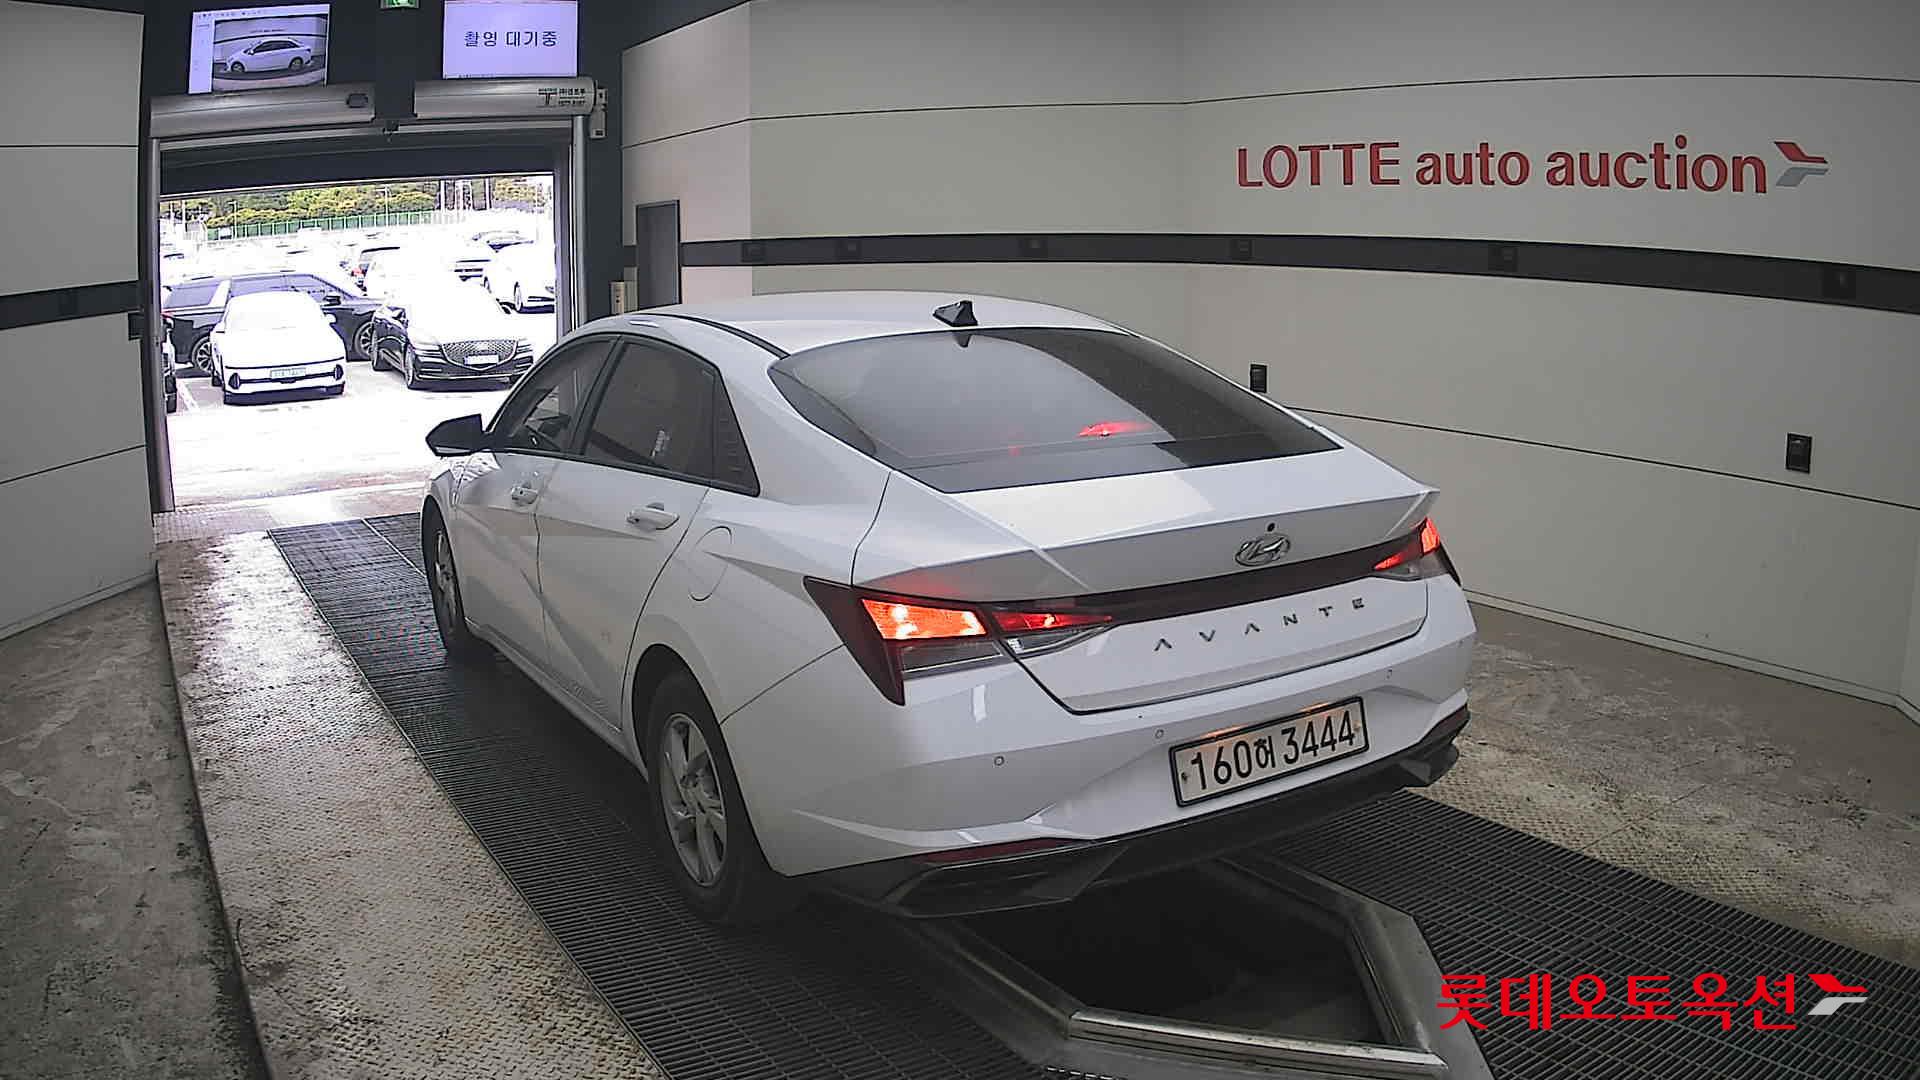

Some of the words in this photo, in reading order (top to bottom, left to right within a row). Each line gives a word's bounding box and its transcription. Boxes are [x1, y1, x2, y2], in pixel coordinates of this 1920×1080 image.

[465, 31, 498, 48] 촬영
[506, 31, 559, 48] 대기중
[1237, 141, 1400, 188] LOTTE
[1415, 142, 1531, 187] auto
[1546, 134, 1767, 194] auction
[1154, 597, 1365, 652] AVANTE
